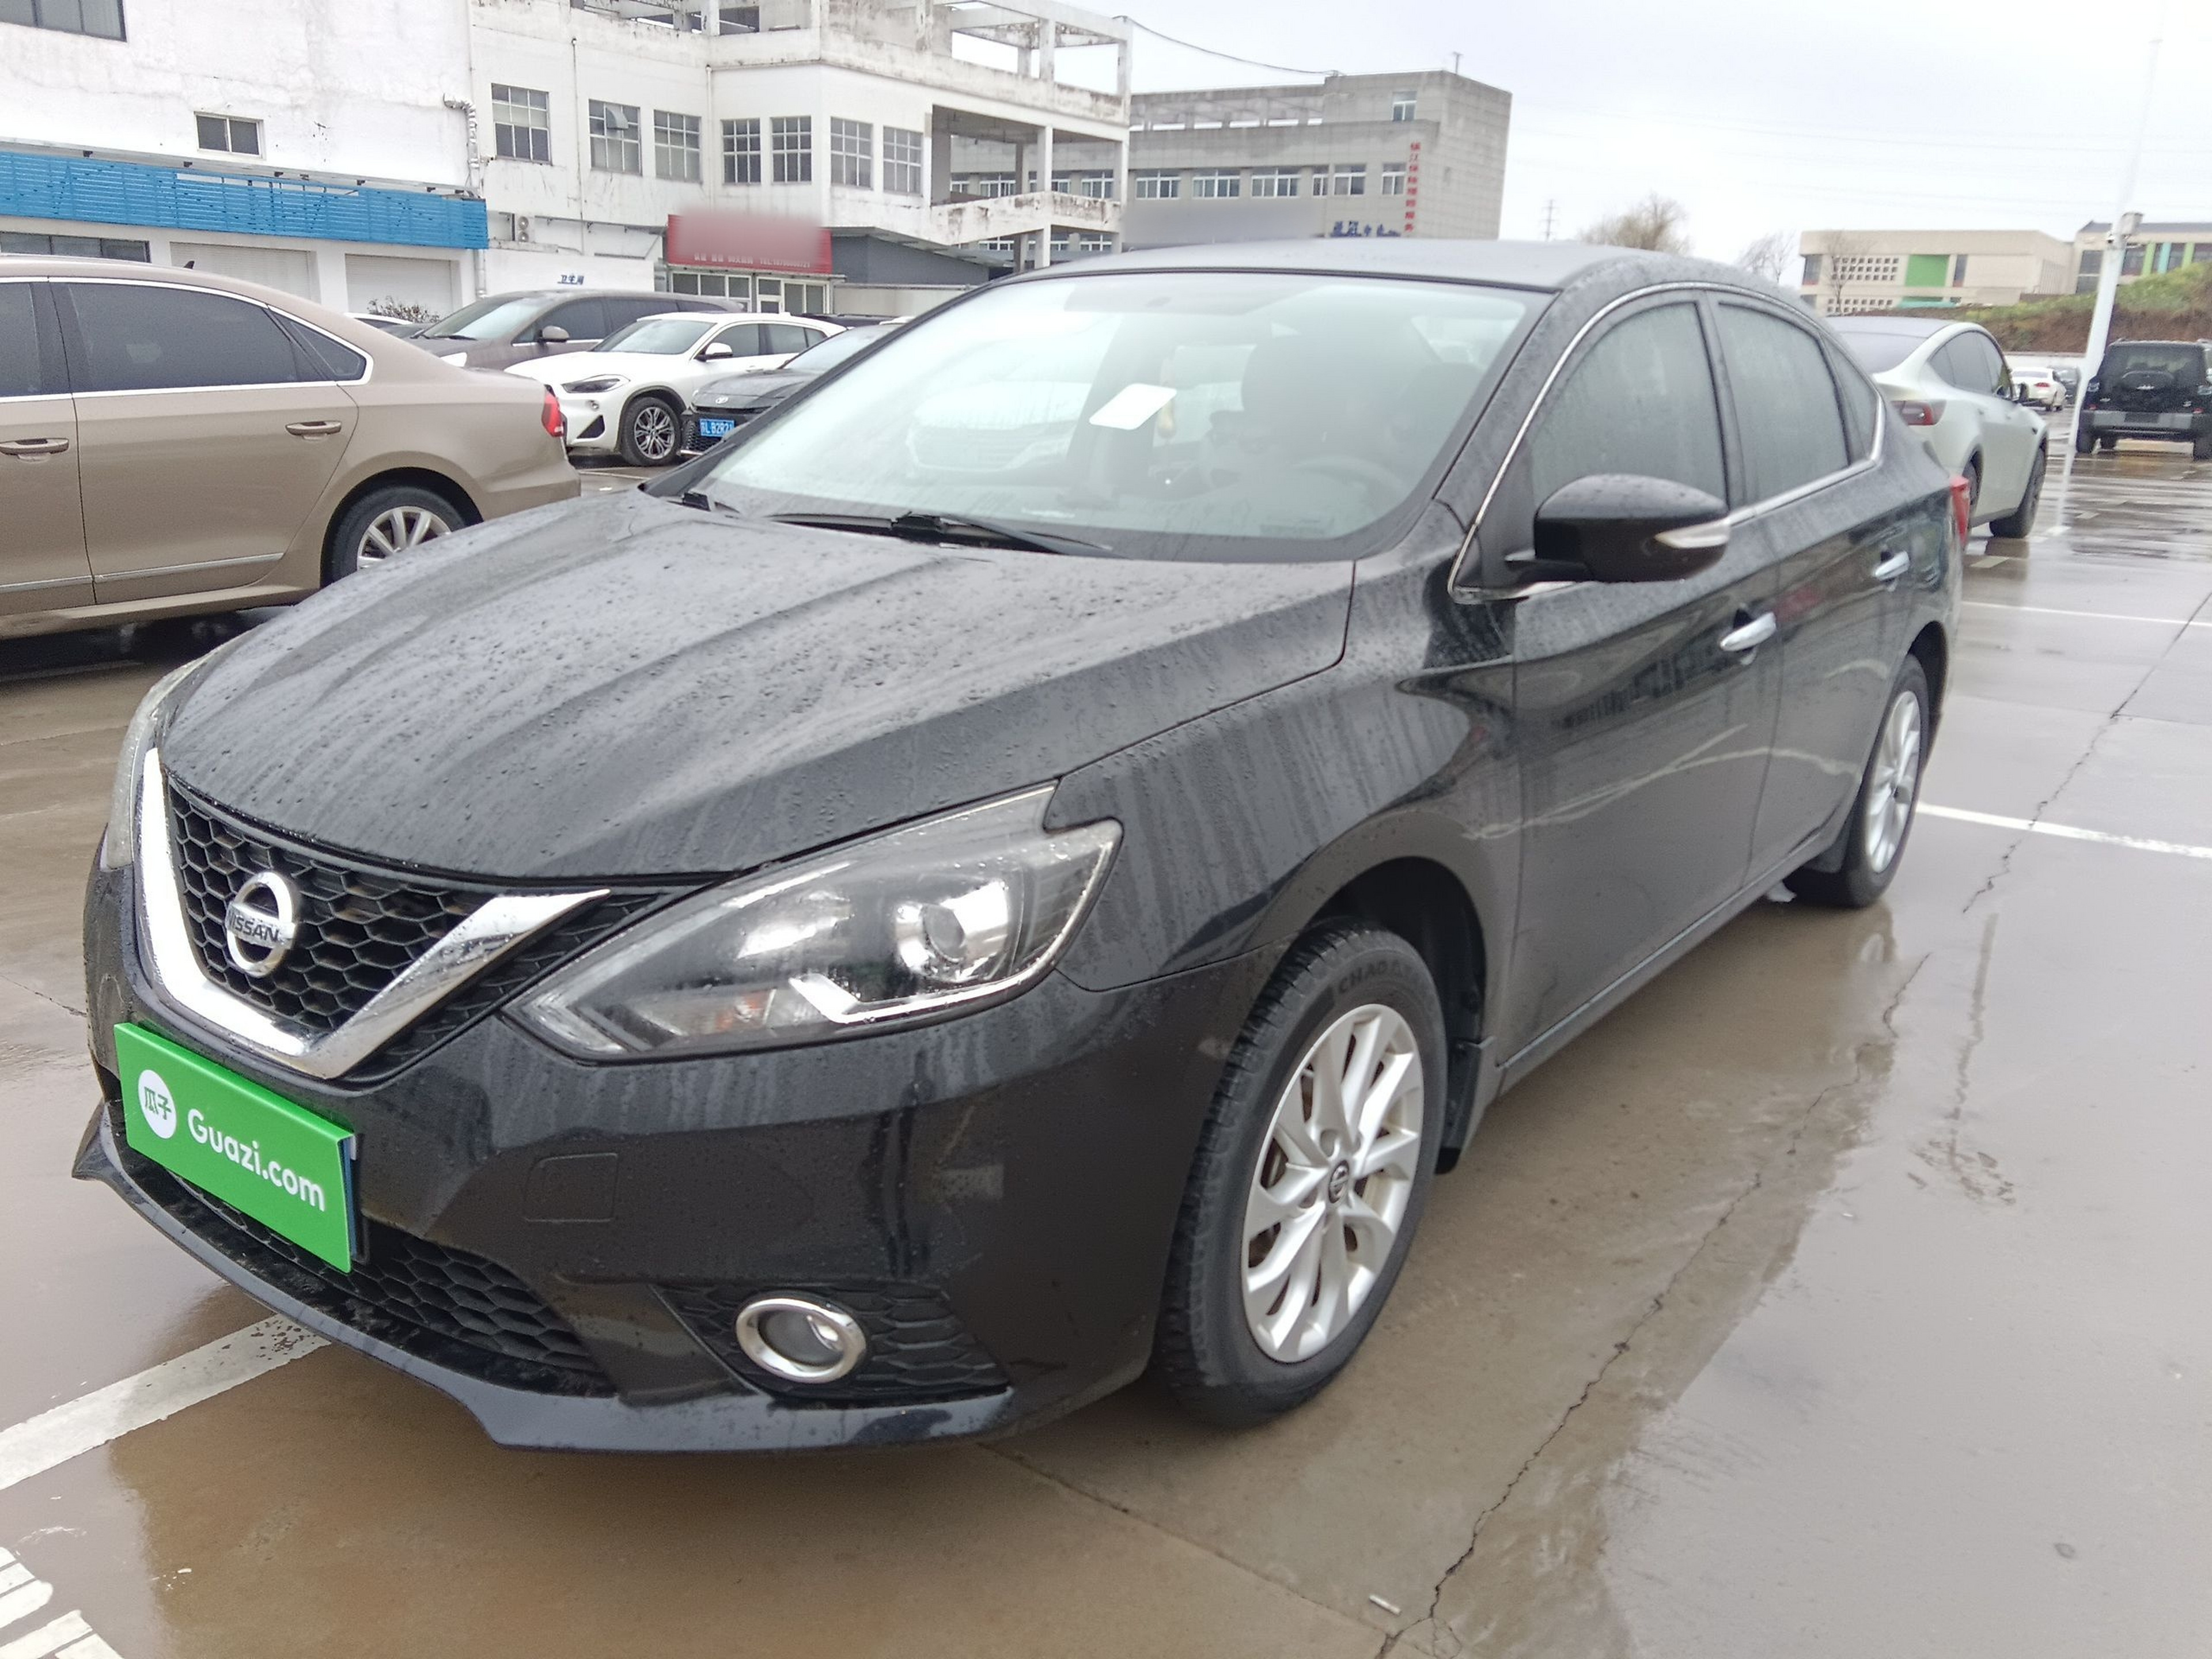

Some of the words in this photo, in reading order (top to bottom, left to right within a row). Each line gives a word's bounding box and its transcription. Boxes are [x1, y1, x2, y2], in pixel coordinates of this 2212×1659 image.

[558, 273, 584, 285] 卫生间
[229, 912, 279, 943] NISSAN
[144, 1086, 172, 1120] 瓜子
[187, 1108, 325, 1213] Guazi.com
